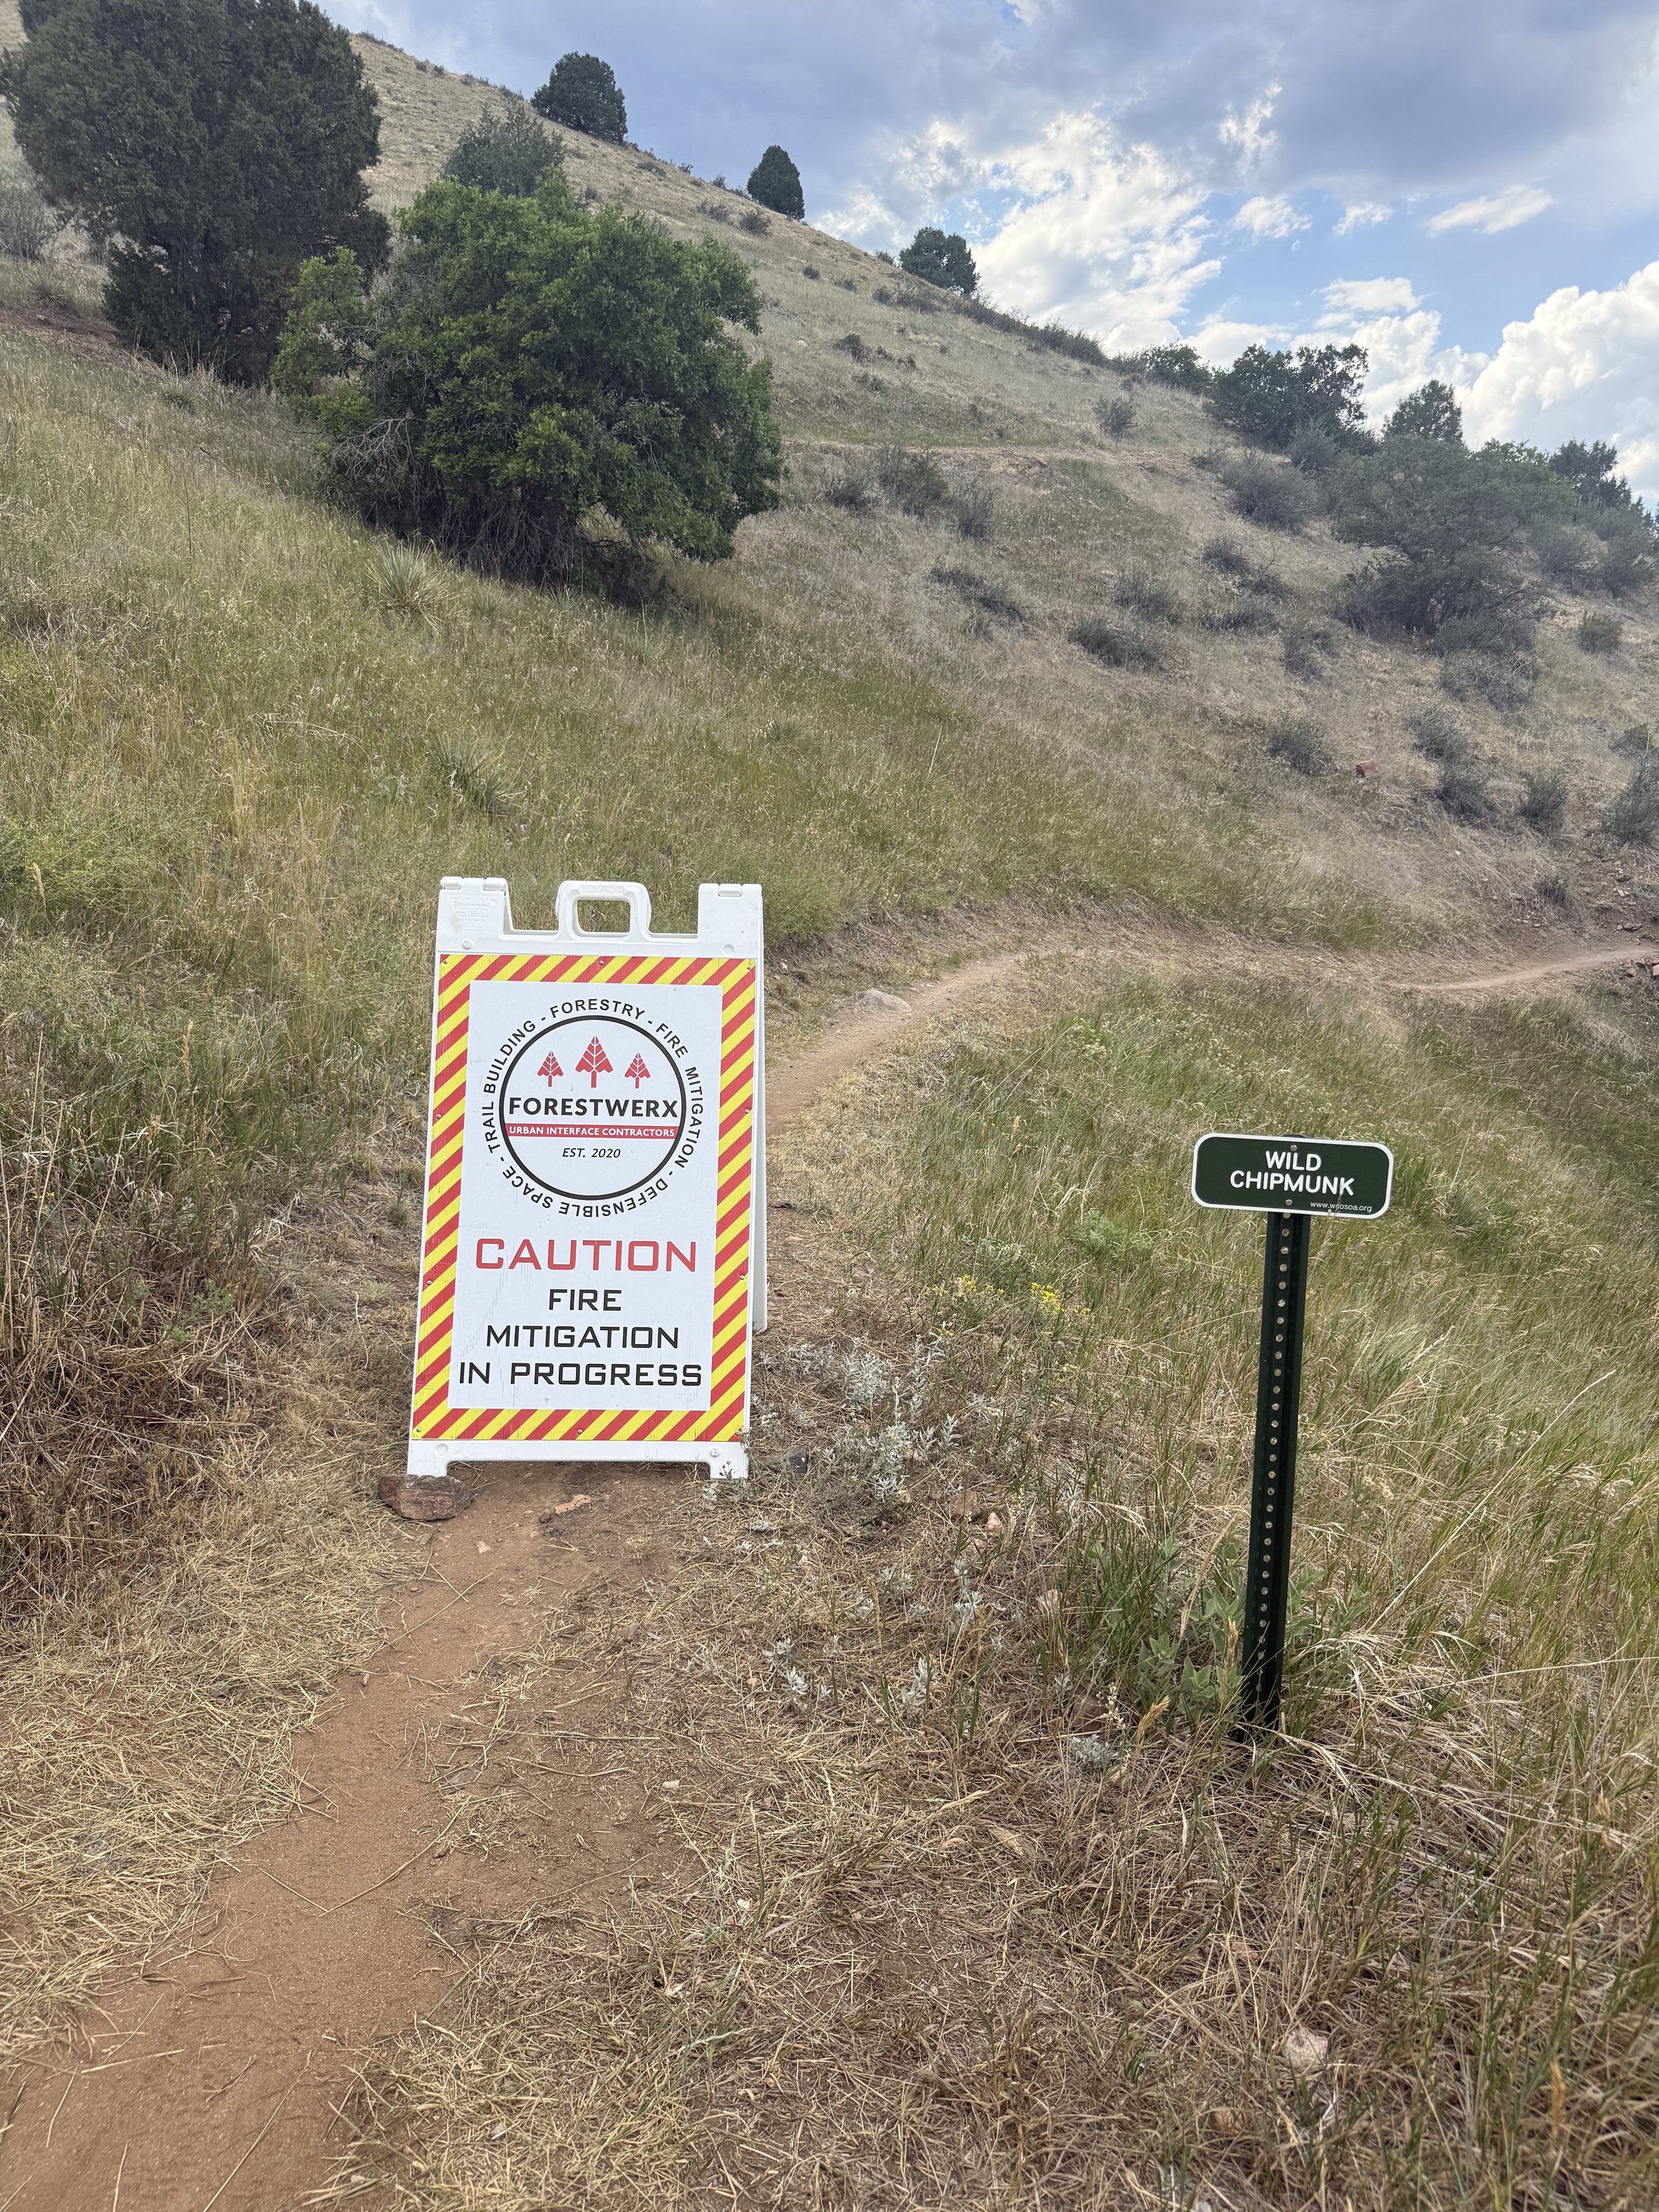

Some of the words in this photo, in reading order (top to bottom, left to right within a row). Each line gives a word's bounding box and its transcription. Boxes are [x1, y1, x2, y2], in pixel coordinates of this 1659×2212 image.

[549, 998, 646, 1021] FORESTRY
[656, 1023, 688, 1059] FIRE
[483, 1020, 536, 1095] BUILDING
[509, 1097, 678, 1118] FORESTWERX
[674, 1066, 703, 1169] MITIGATION
[482, 1101, 502, 1153] TRAIL
[509, 1126, 544, 1135] URBAN
[546, 1127, 600, 1136] INTERFACE
[602, 1128, 675, 1137] CONTRACTORS
[562, 1147, 585, 1158] EST.
[591, 1148, 621, 1158] 2020
[1265, 1150, 1321, 1171] WILD
[502, 1165, 553, 1209] SPACE
[1230, 1169, 1354, 1196] CHIPMUNK
[559, 1178, 669, 1218] DEFENSIBLE
[476, 1238, 696, 1272] CAUTION
[549, 1289, 622, 1311] FIRE
[486, 1325, 679, 1349] MITIGATION
[459, 1362, 490, 1384] IN
[510, 1363, 701, 1386] PROGRESS
